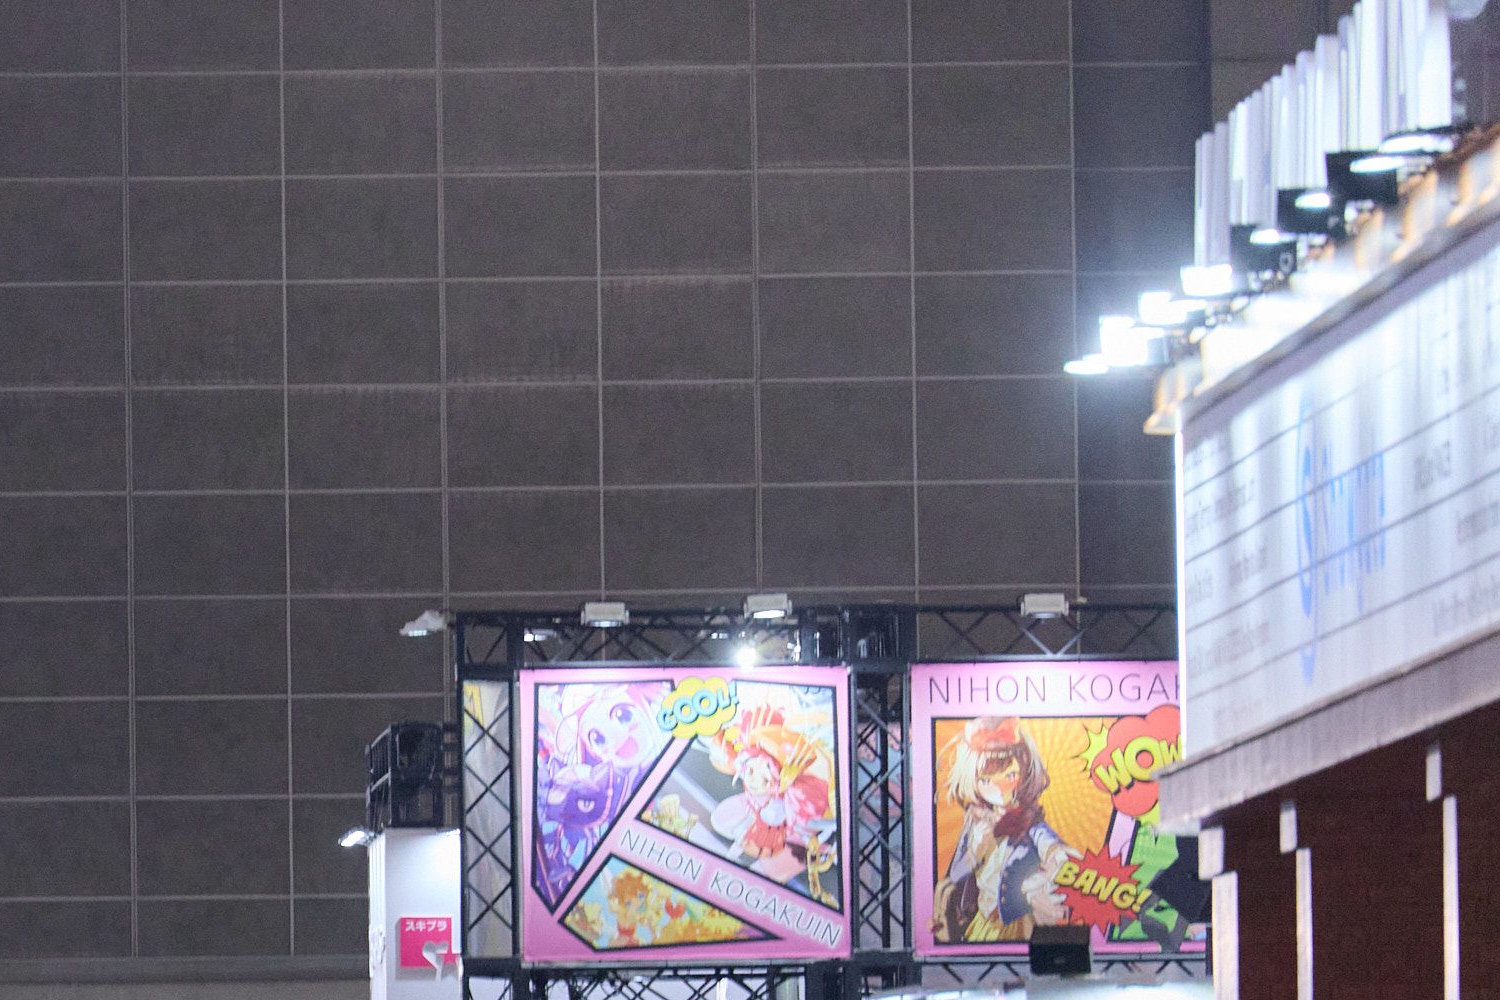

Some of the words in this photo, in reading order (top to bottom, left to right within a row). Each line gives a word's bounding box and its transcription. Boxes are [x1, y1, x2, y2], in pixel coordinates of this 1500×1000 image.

[656, 679, 740, 732] COOL!
[929, 675, 1047, 704] NIHON
[1095, 734, 1182, 794] WOW
[619, 829, 703, 882] NIHON
[709, 870, 842, 947] KOGAKUIN
[1054, 861, 1153, 913] BANG!
